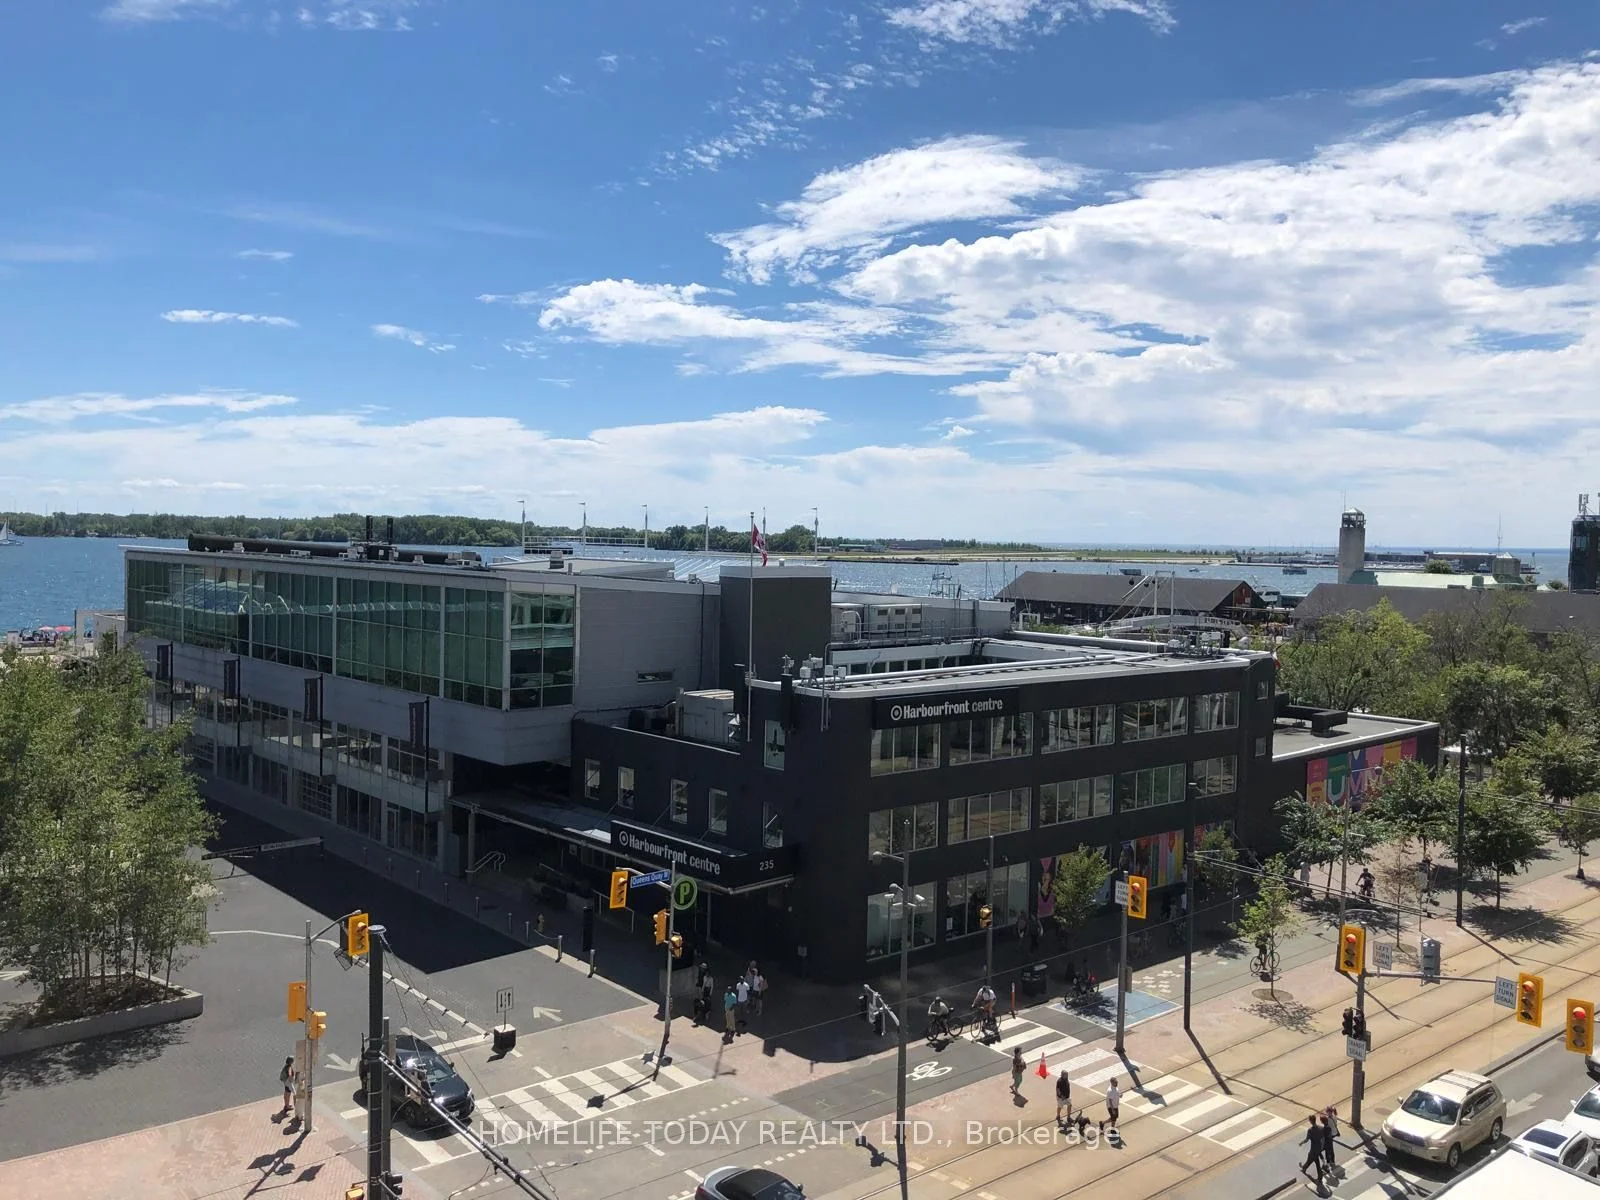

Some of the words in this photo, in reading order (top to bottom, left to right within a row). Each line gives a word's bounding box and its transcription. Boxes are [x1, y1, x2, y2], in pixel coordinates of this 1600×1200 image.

[903, 700, 969, 719] Harbourfront
[971, 697, 1003, 712] centre
[629, 833, 687, 865] Harbourfront
[689, 854, 720, 875] centre
[759, 860, 774, 871] 235
[632, 875, 650, 885] Queens
[650, 872, 664, 882] Quay
[680, 882, 690, 904] P
[1498, 980, 1514, 990] LEFT
[1498, 987, 1514, 998] TURN
